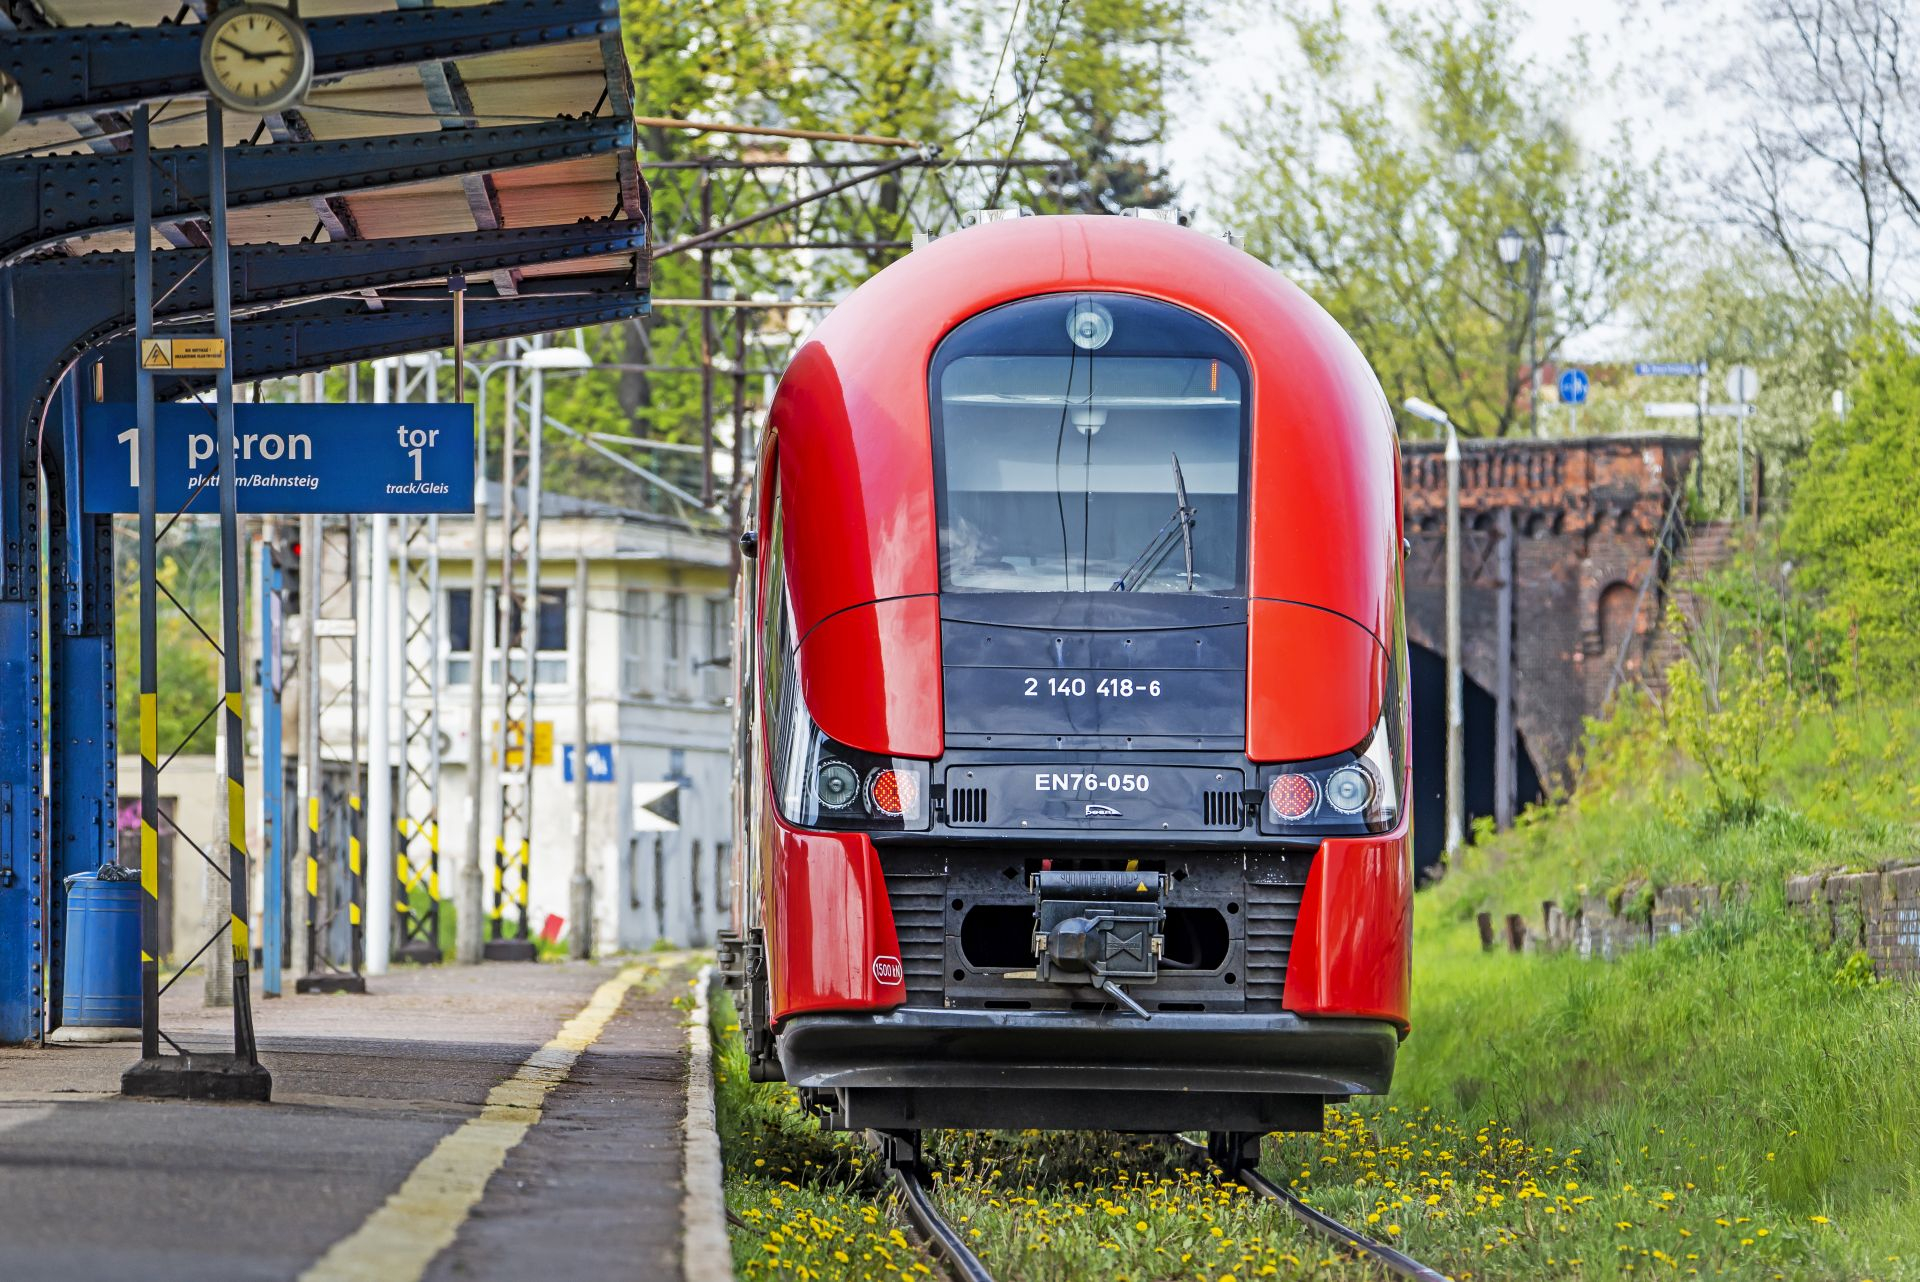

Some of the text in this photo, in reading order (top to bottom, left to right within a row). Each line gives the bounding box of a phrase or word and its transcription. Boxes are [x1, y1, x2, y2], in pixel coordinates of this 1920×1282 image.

[396, 425, 440, 448] tor
[117, 428, 139, 487] 1
[408, 448, 422, 480] 1
[385, 482, 449, 495] track/Gleis
[1024, 677, 1161, 697] 2 140 418-6
[1035, 773, 1150, 792] EN76-050
